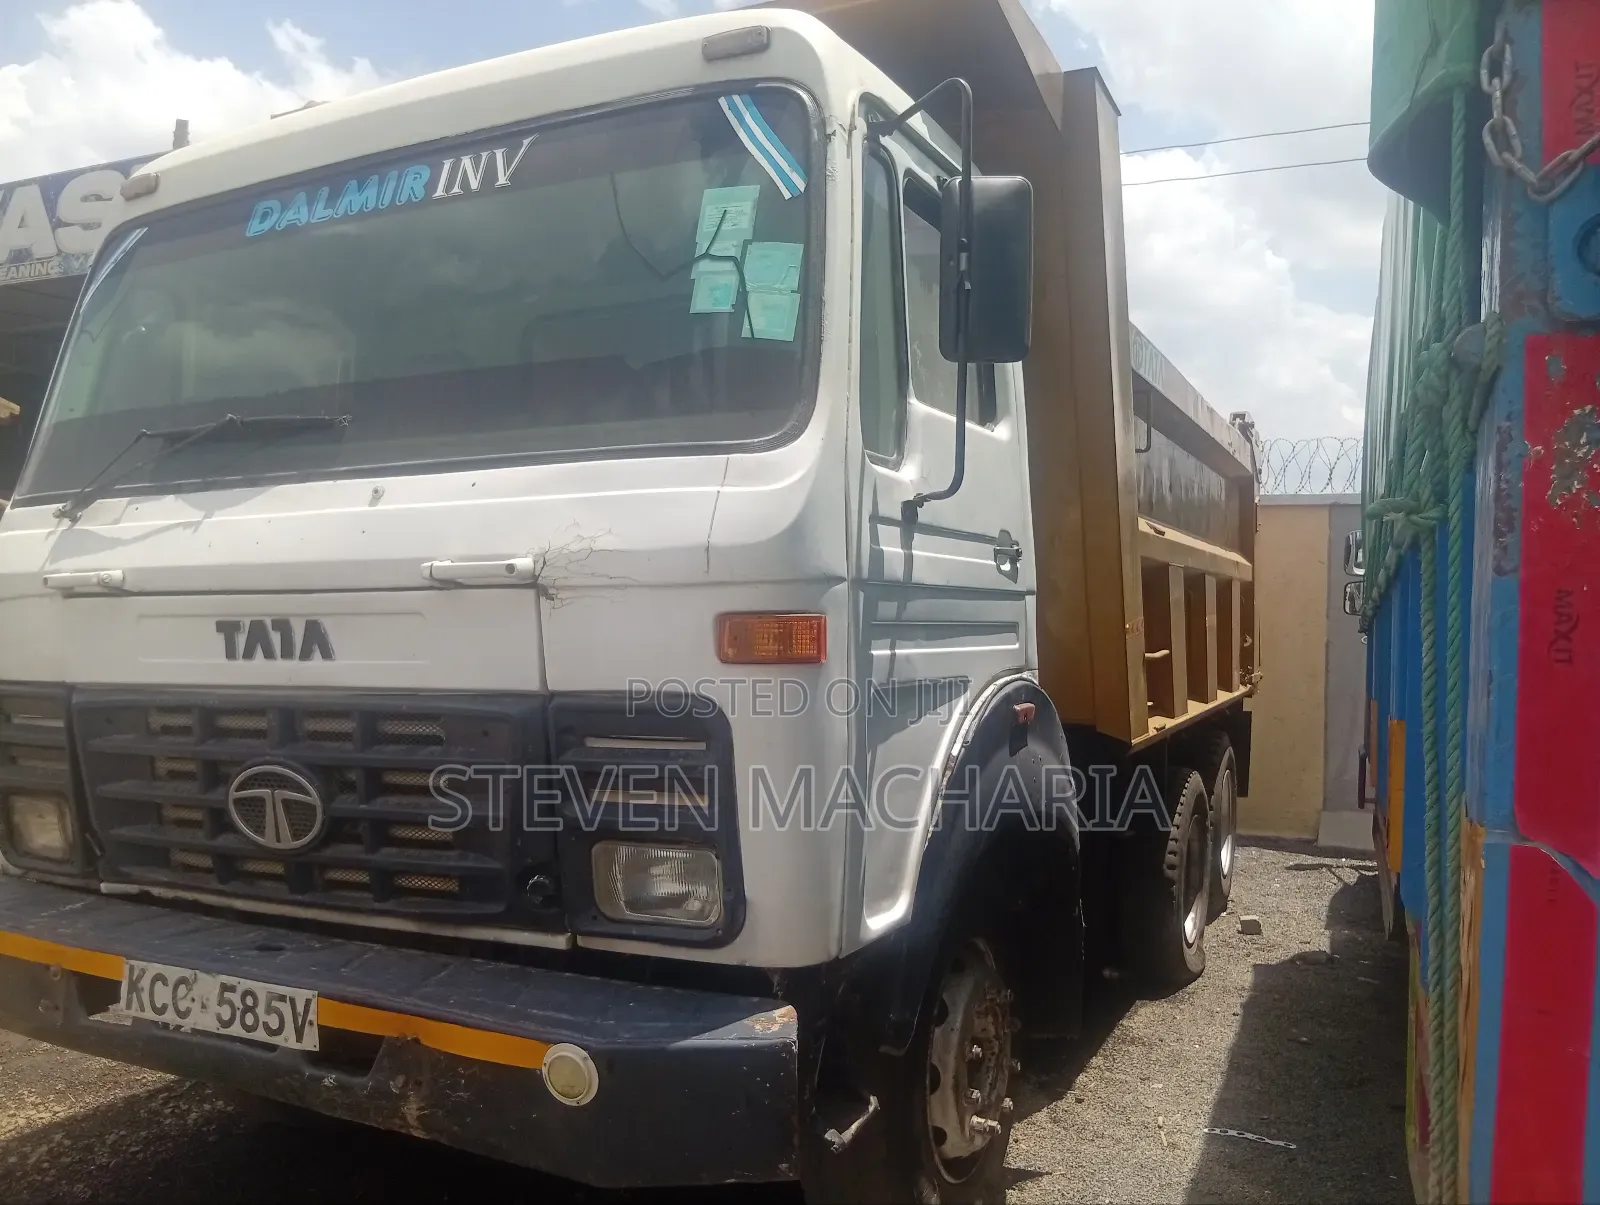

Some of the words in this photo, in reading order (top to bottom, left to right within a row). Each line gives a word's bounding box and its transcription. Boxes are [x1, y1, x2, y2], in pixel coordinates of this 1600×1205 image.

[1569, 60, 1600, 137] MAXIT
[245, 164, 431, 237] DALMIR
[432, 132, 539, 200] INV
[216, 618, 336, 661] TATA
[1547, 587, 1580, 667] MAXIT
[125, 964, 194, 1020] KCC
[215, 982, 312, 1044] 585V
